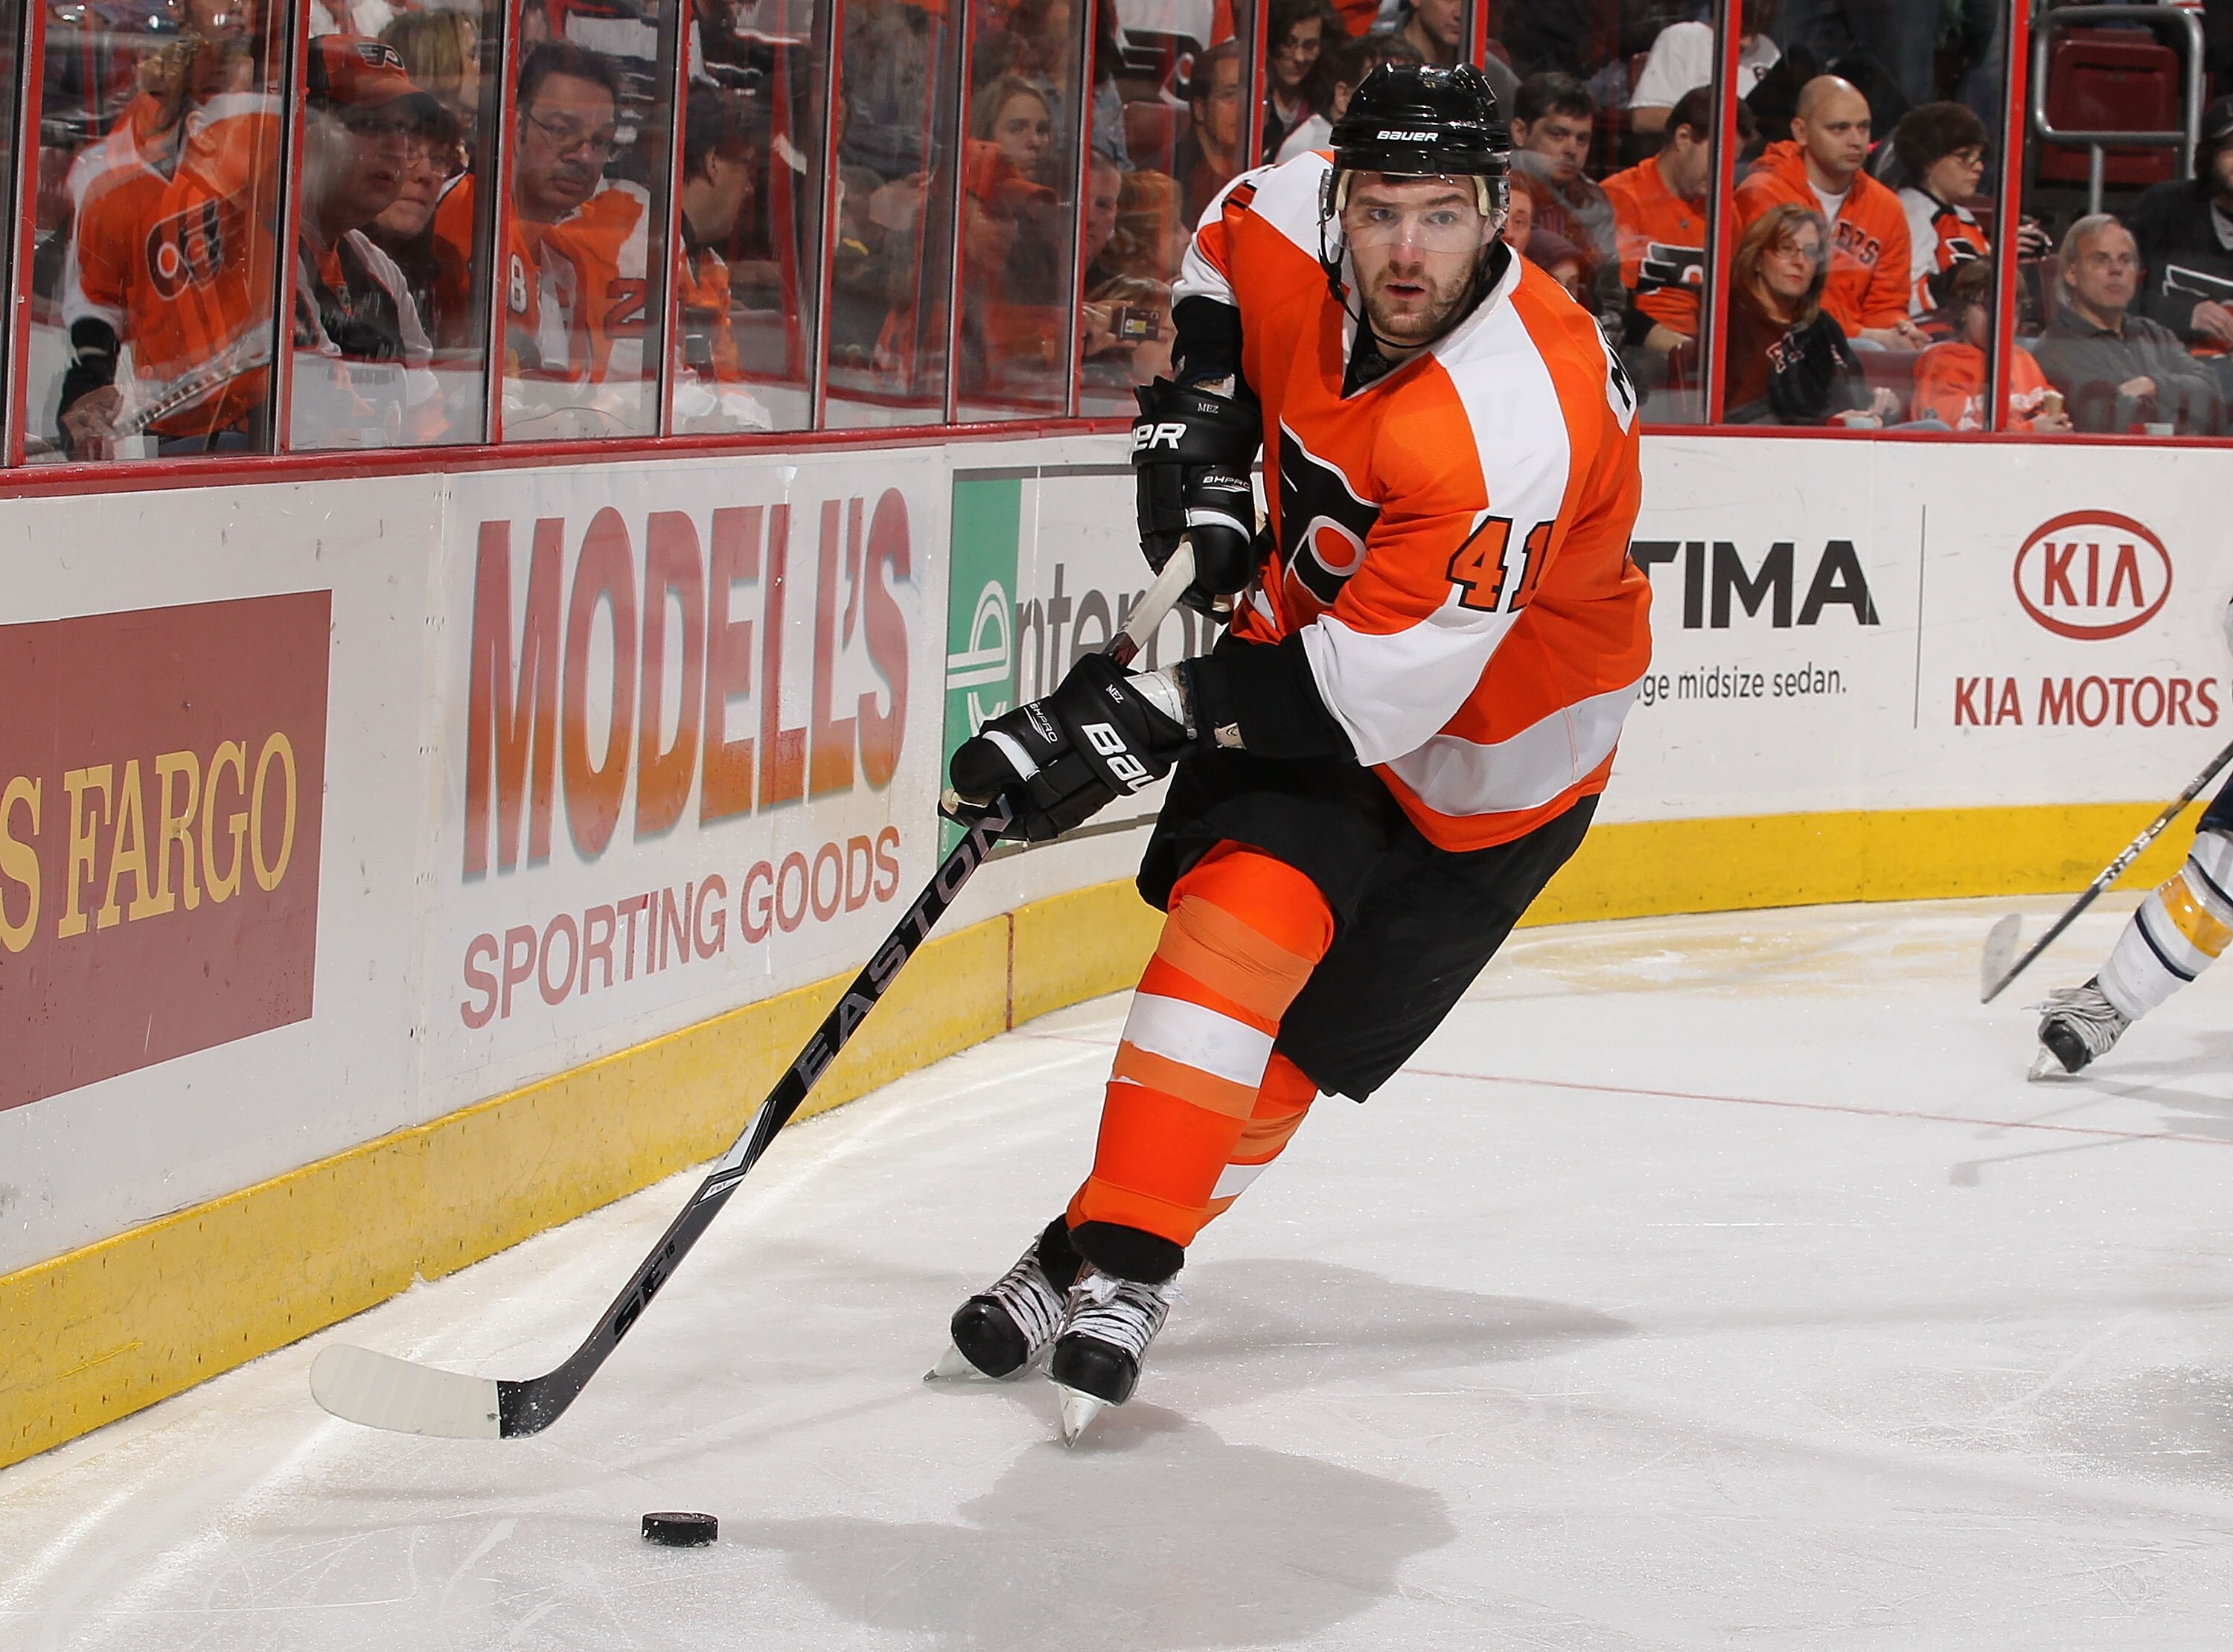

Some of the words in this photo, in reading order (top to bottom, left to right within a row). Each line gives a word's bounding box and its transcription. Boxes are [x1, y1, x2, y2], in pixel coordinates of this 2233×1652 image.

[1197, 403, 1219, 414] MEZ
[1446, 515, 1556, 615] 41
[2043, 542, 2145, 609] KIA
[463, 487, 913, 884] MODELL'S
[1105, 683, 1125, 704] MEZ
[1637, 673, 1670, 707] ge
[1678, 665, 1764, 699] midsize
[1773, 662, 1847, 697] sedan.
[1954, 676, 2022, 727] KIA
[2037, 675, 2220, 728] MOTORS
[57, 731, 298, 939] FARGO
[461, 874, 729, 1029] SPORTING
[741, 825, 901, 944] GOODS
[796, 793, 1014, 1093] EASTON
